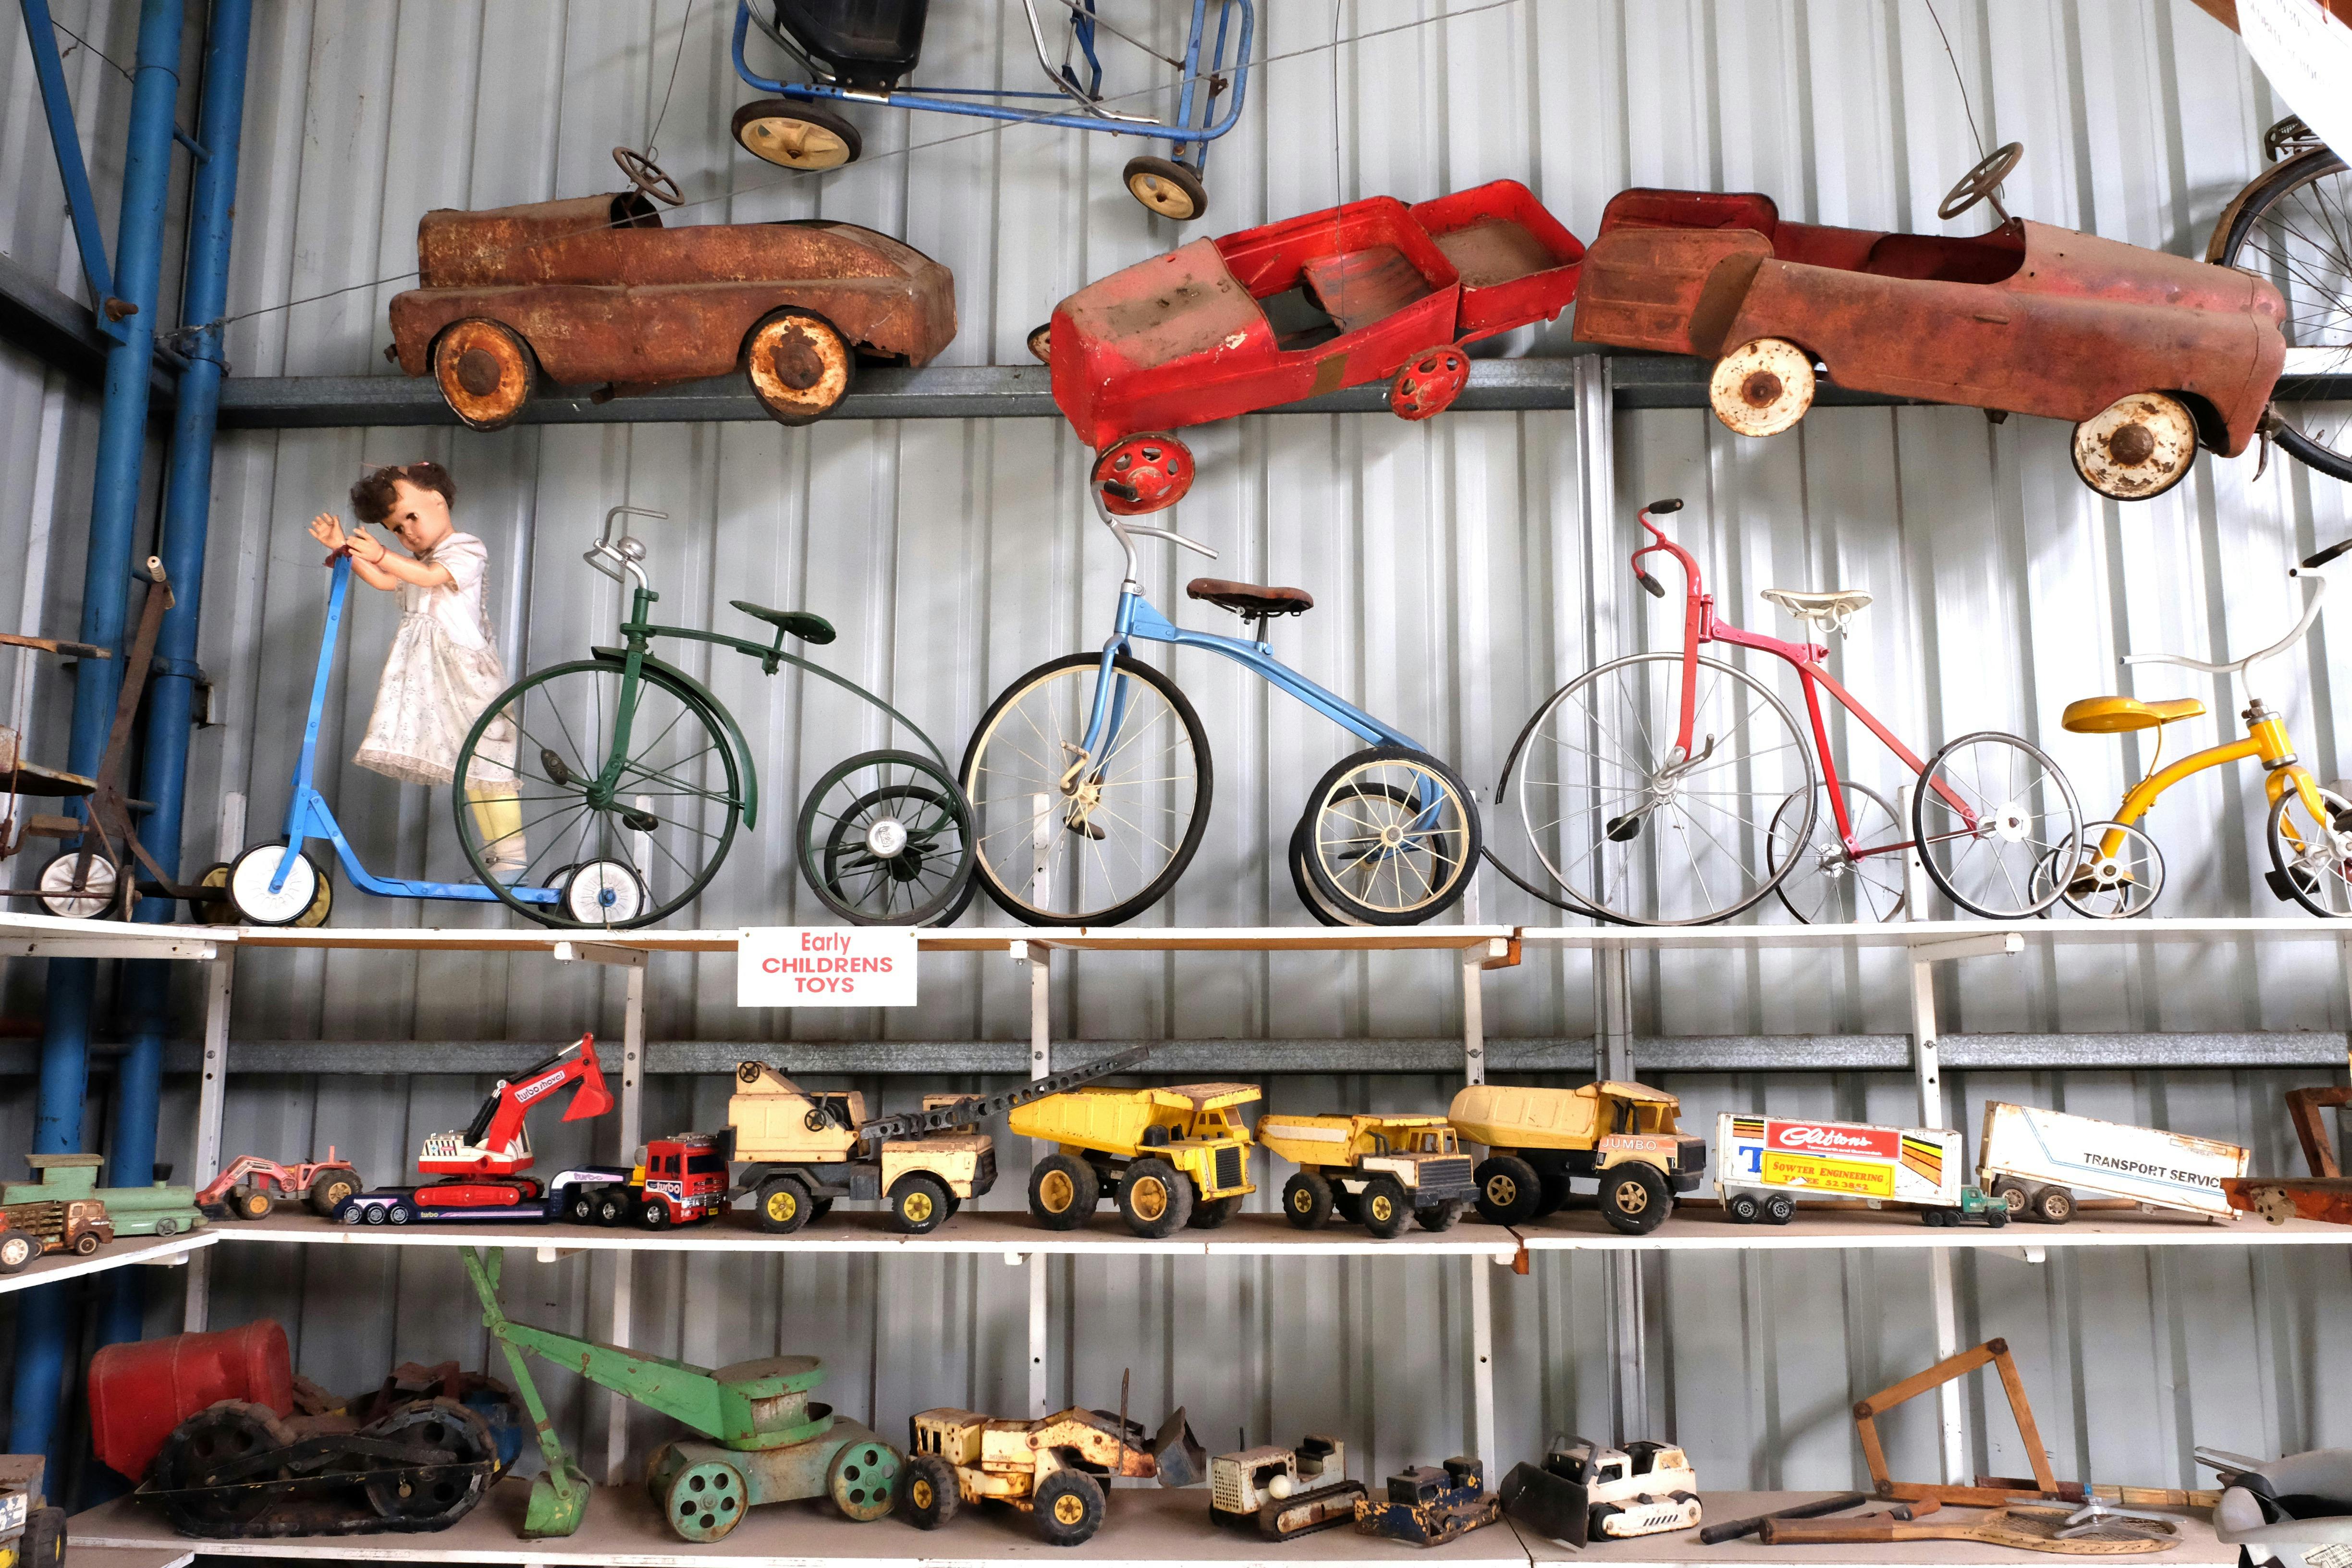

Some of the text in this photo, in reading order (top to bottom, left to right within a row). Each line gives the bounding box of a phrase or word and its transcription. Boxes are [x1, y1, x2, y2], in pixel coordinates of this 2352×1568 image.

[801, 932, 851, 955] Early
[762, 957, 893, 973] CHILDRENS
[795, 977, 854, 993] TOYS
[516, 1087, 539, 1101] turbo
[1602, 1138, 1657, 1151] JUMBO
[574, 1172, 603, 1180] turbo
[1773, 1161, 1815, 1175] SOWTER
[1819, 1168, 1884, 1183] ENGINEERING
[2083, 1152, 2167, 1177] TRANSPORT
[2169, 1169, 2221, 1188] SERVIC
[1783, 1175, 1819, 1185] TAEE
[656, 1182, 680, 1194] turbo
